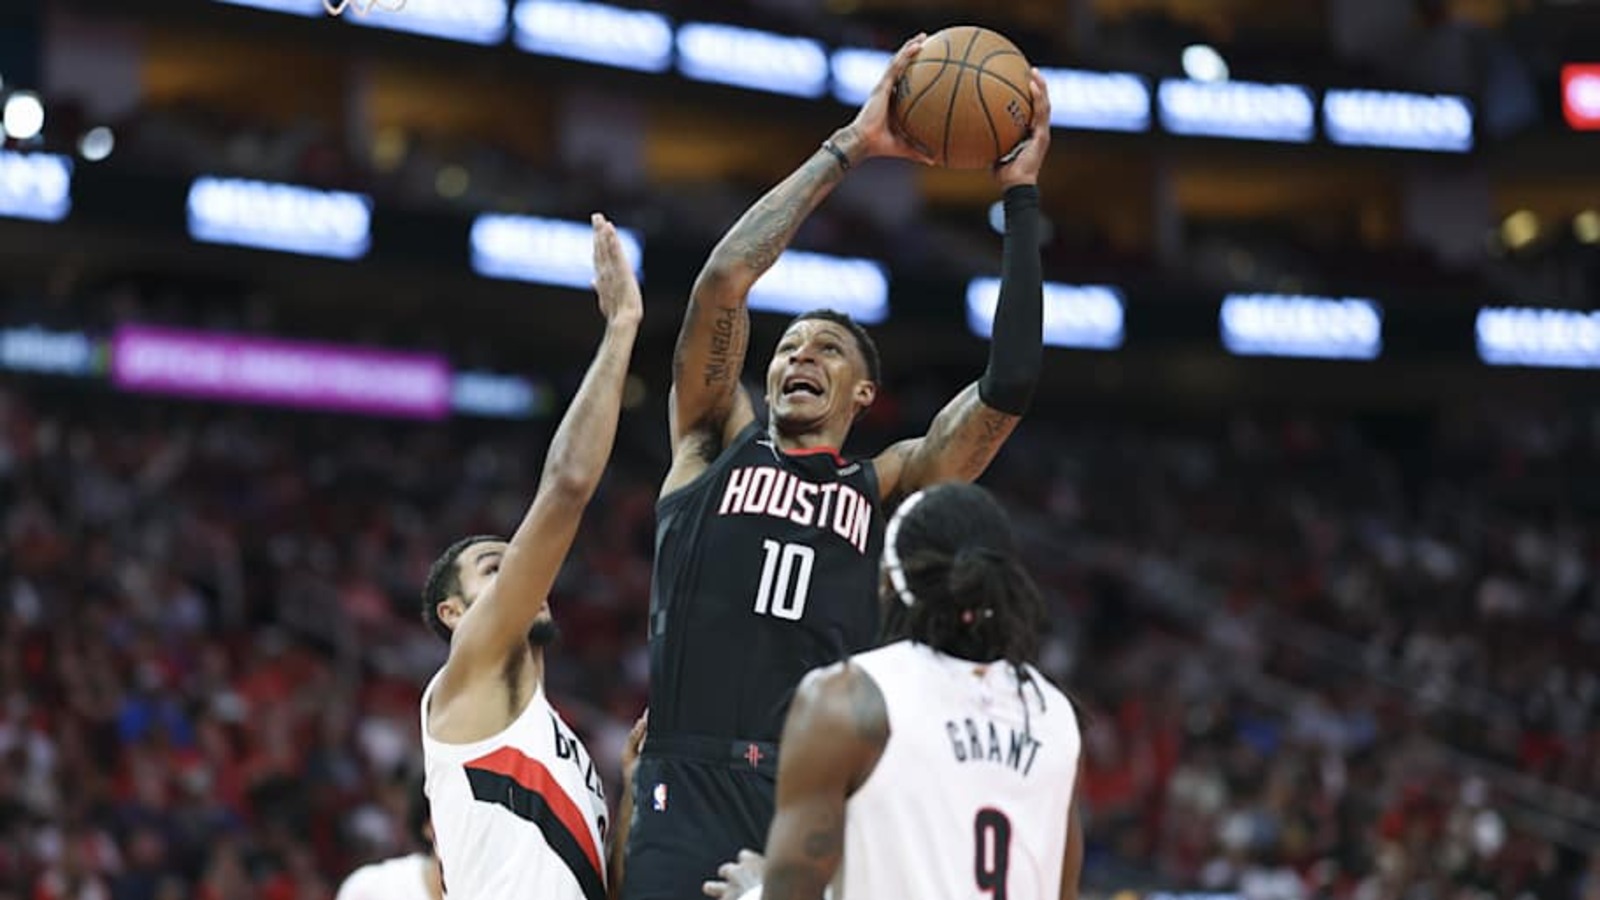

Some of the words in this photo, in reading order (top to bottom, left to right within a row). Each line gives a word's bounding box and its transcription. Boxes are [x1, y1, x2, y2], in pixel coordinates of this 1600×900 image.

[717, 465, 873, 556] HOUSTON
[753, 538, 816, 622] 10
[945, 717, 1043, 778] GRANT
[974, 806, 1012, 900] 9
